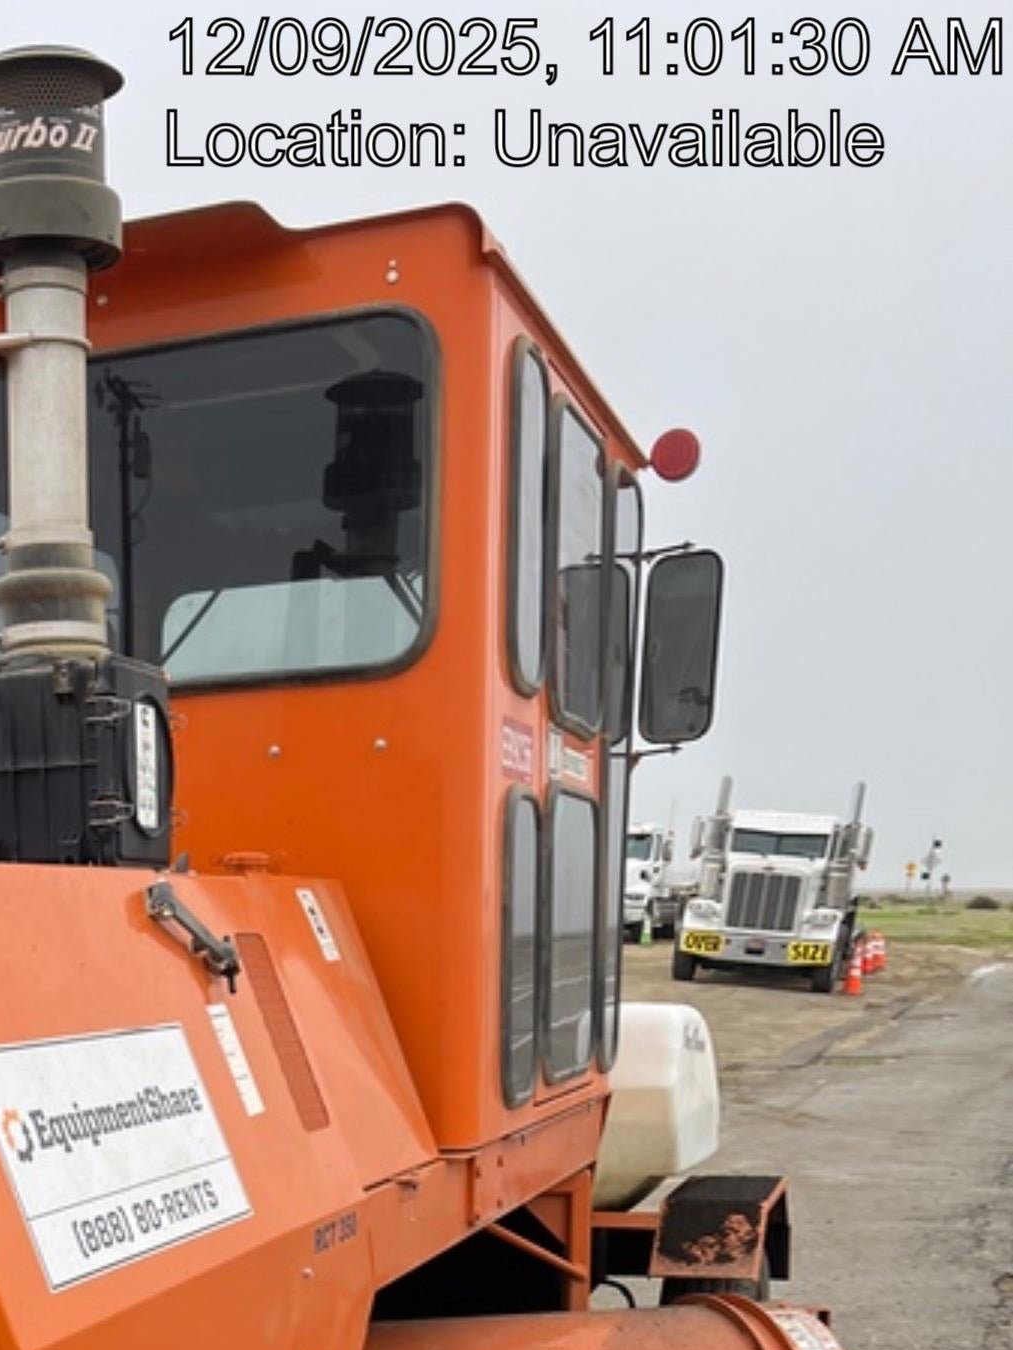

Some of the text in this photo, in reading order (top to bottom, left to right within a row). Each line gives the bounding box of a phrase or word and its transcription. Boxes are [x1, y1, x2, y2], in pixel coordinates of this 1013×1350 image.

[685, 932, 722, 952] OVER
[29, 1085, 203, 1153] EquipmentShare
[71, 1205, 134, 1258] (888)
